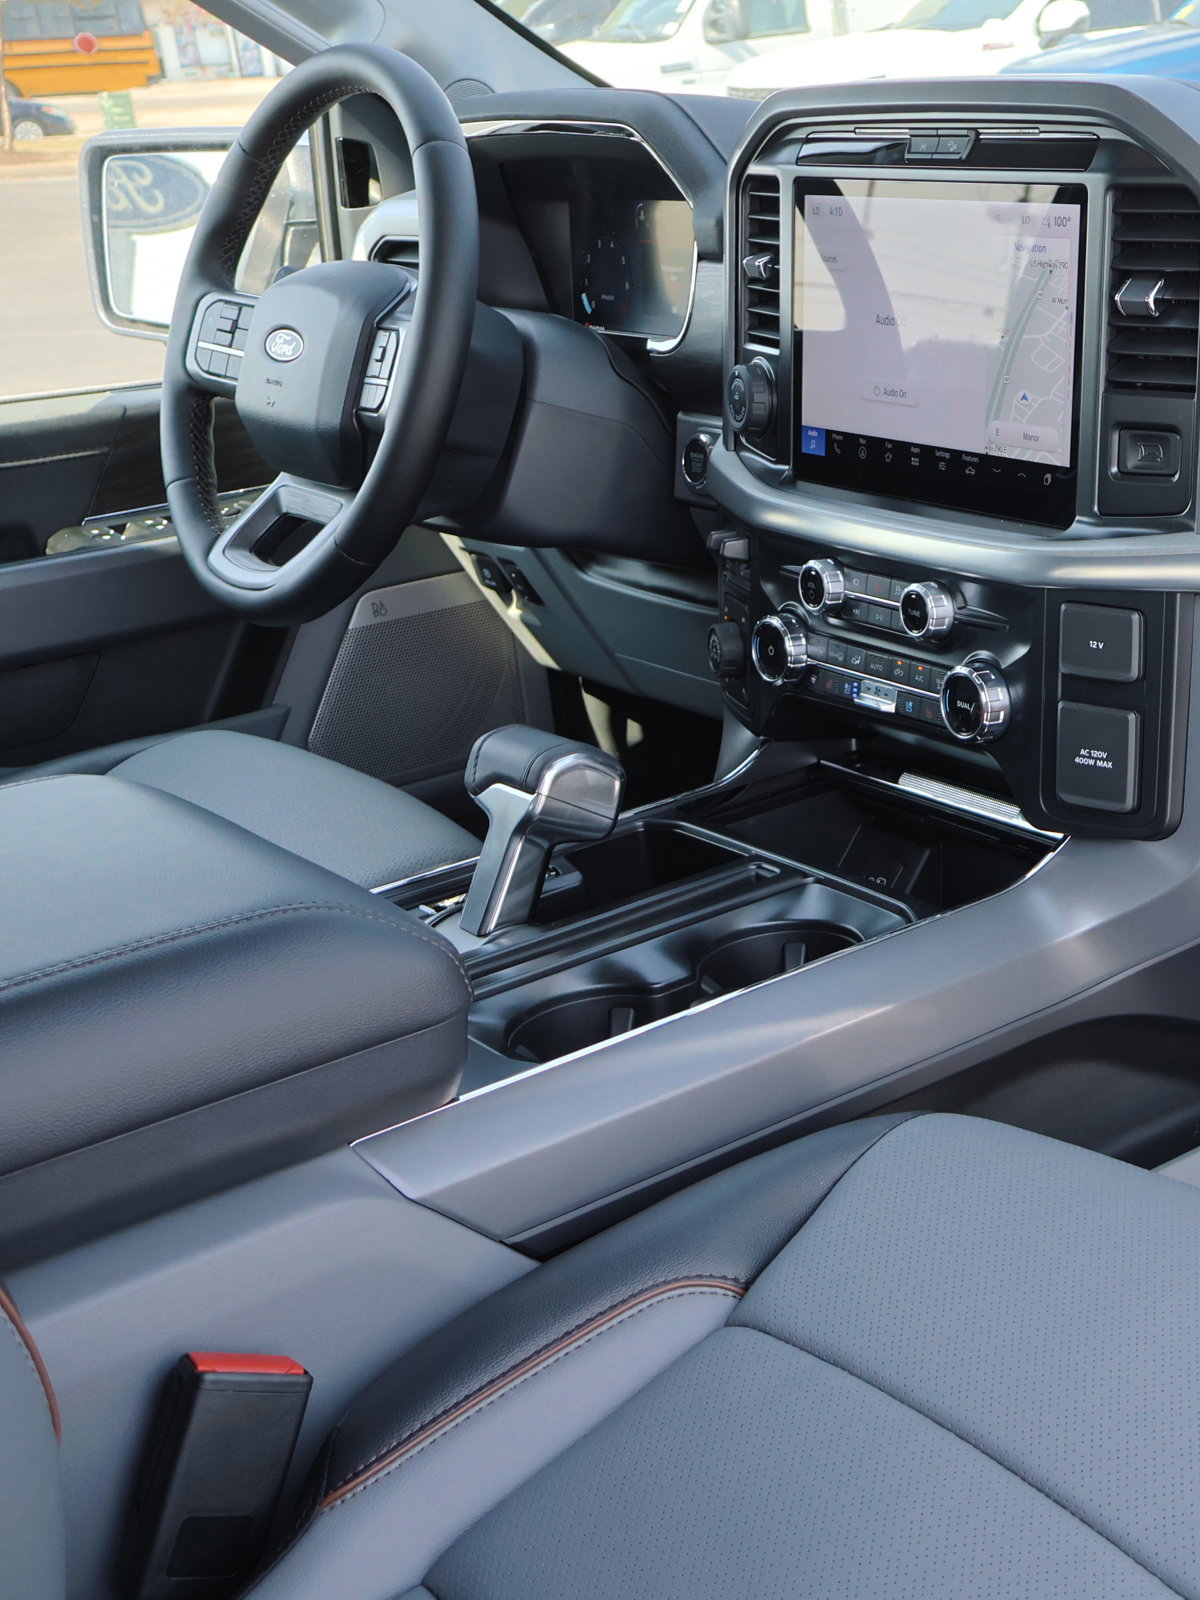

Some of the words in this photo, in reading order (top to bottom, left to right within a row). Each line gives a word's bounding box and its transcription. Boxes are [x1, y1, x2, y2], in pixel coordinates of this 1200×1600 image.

[876, 313, 895, 327] Audio
[883, 387, 898, 398] Audio
[899, 388, 907, 398] On
[807, 429, 818, 437] Audio
[908, 608, 921, 617] TUNE
[1089, 640, 1097, 648] 12
[1098, 641, 1104, 649] V
[869, 662, 884, 672] AUTO
[914, 674, 924, 683] A/C
[1079, 748, 1089, 757] AC
[1090, 749, 1107, 759] 120V
[1074, 756, 1096, 766] 400W
[1096, 759, 1112, 769] MAX
